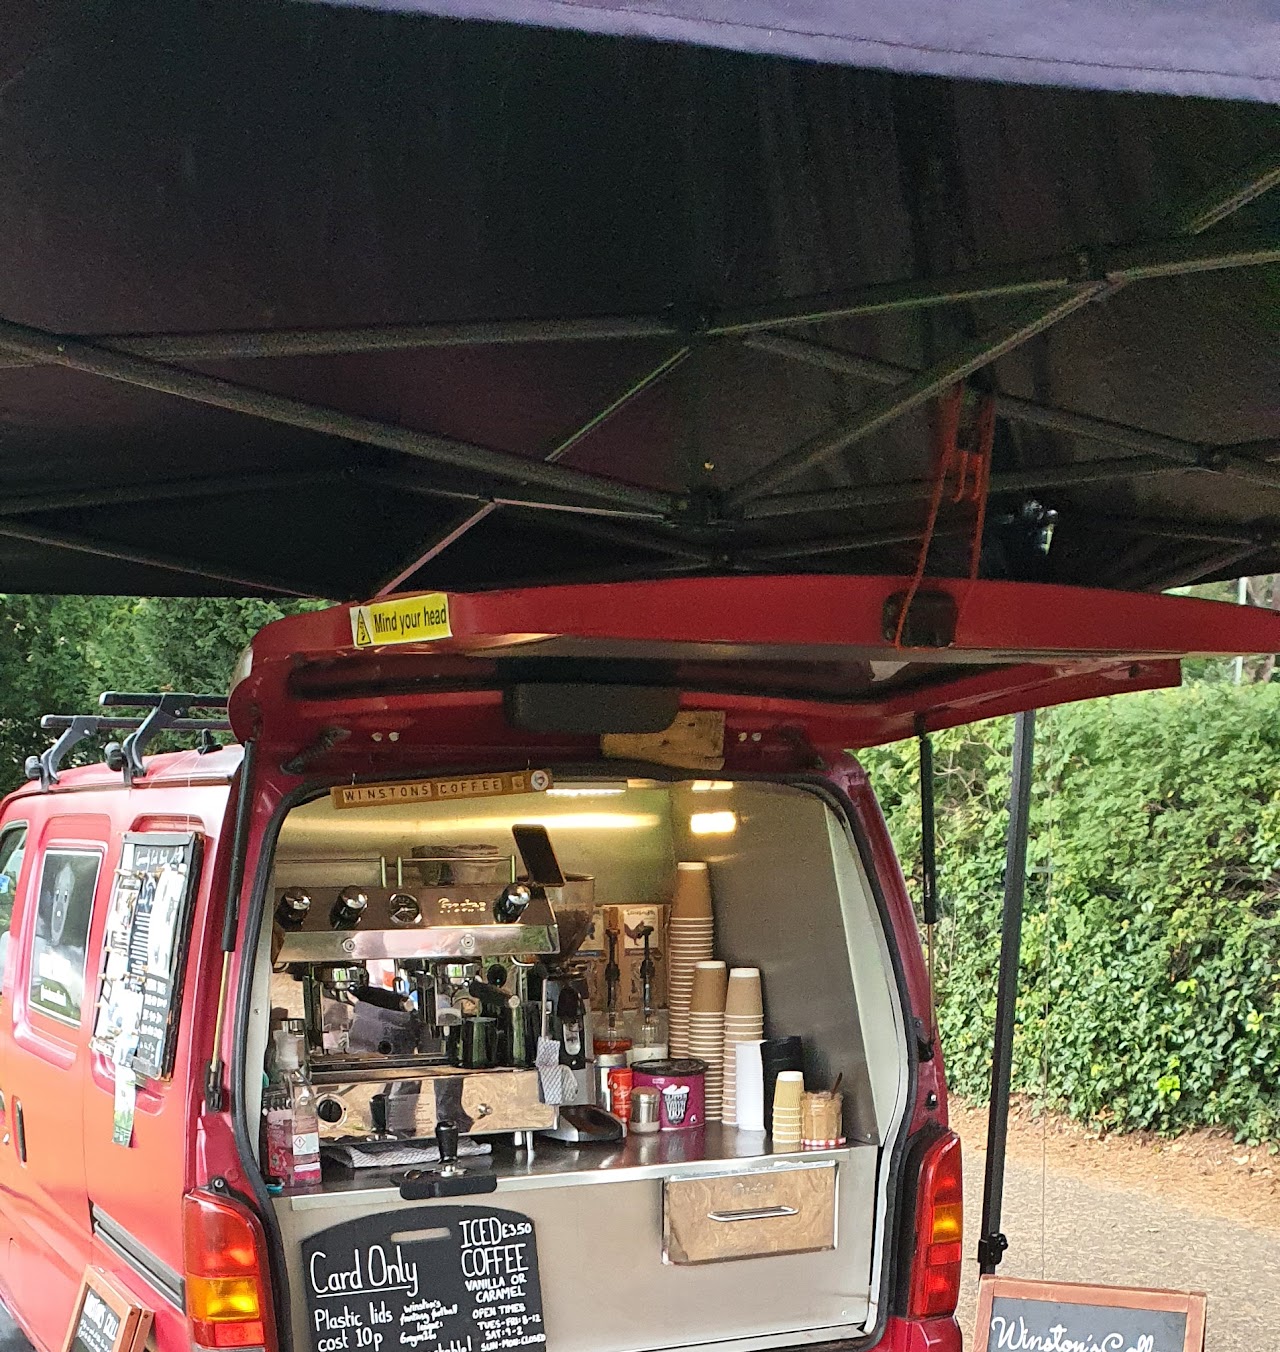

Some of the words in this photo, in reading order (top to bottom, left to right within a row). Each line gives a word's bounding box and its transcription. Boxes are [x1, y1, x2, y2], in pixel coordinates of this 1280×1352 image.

[373, 611, 397, 634] Mind
[399, 612, 421, 636] your
[423, 603, 447, 627] head
[344, 784, 429, 801] WINSTONS
[439, 780, 500, 795] COFFEE
[459, 1217, 502, 1249] ICED
[310, 1248, 363, 1294] Card
[368, 1245, 419, 1297] Only
[461, 1243, 529, 1278] COFFEE
[464, 1276, 506, 1292] VANILLA
[510, 1272, 528, 1286] OR
[475, 1285, 526, 1304] CARAMEL
[314, 1305, 363, 1332] Plastic
[369, 1300, 394, 1325] lids
[472, 1306, 497, 1320] OPEN
[498, 1302, 526, 1316] TIMES
[317, 1329, 349, 1352] cost
[355, 1327, 383, 1352] 10p
